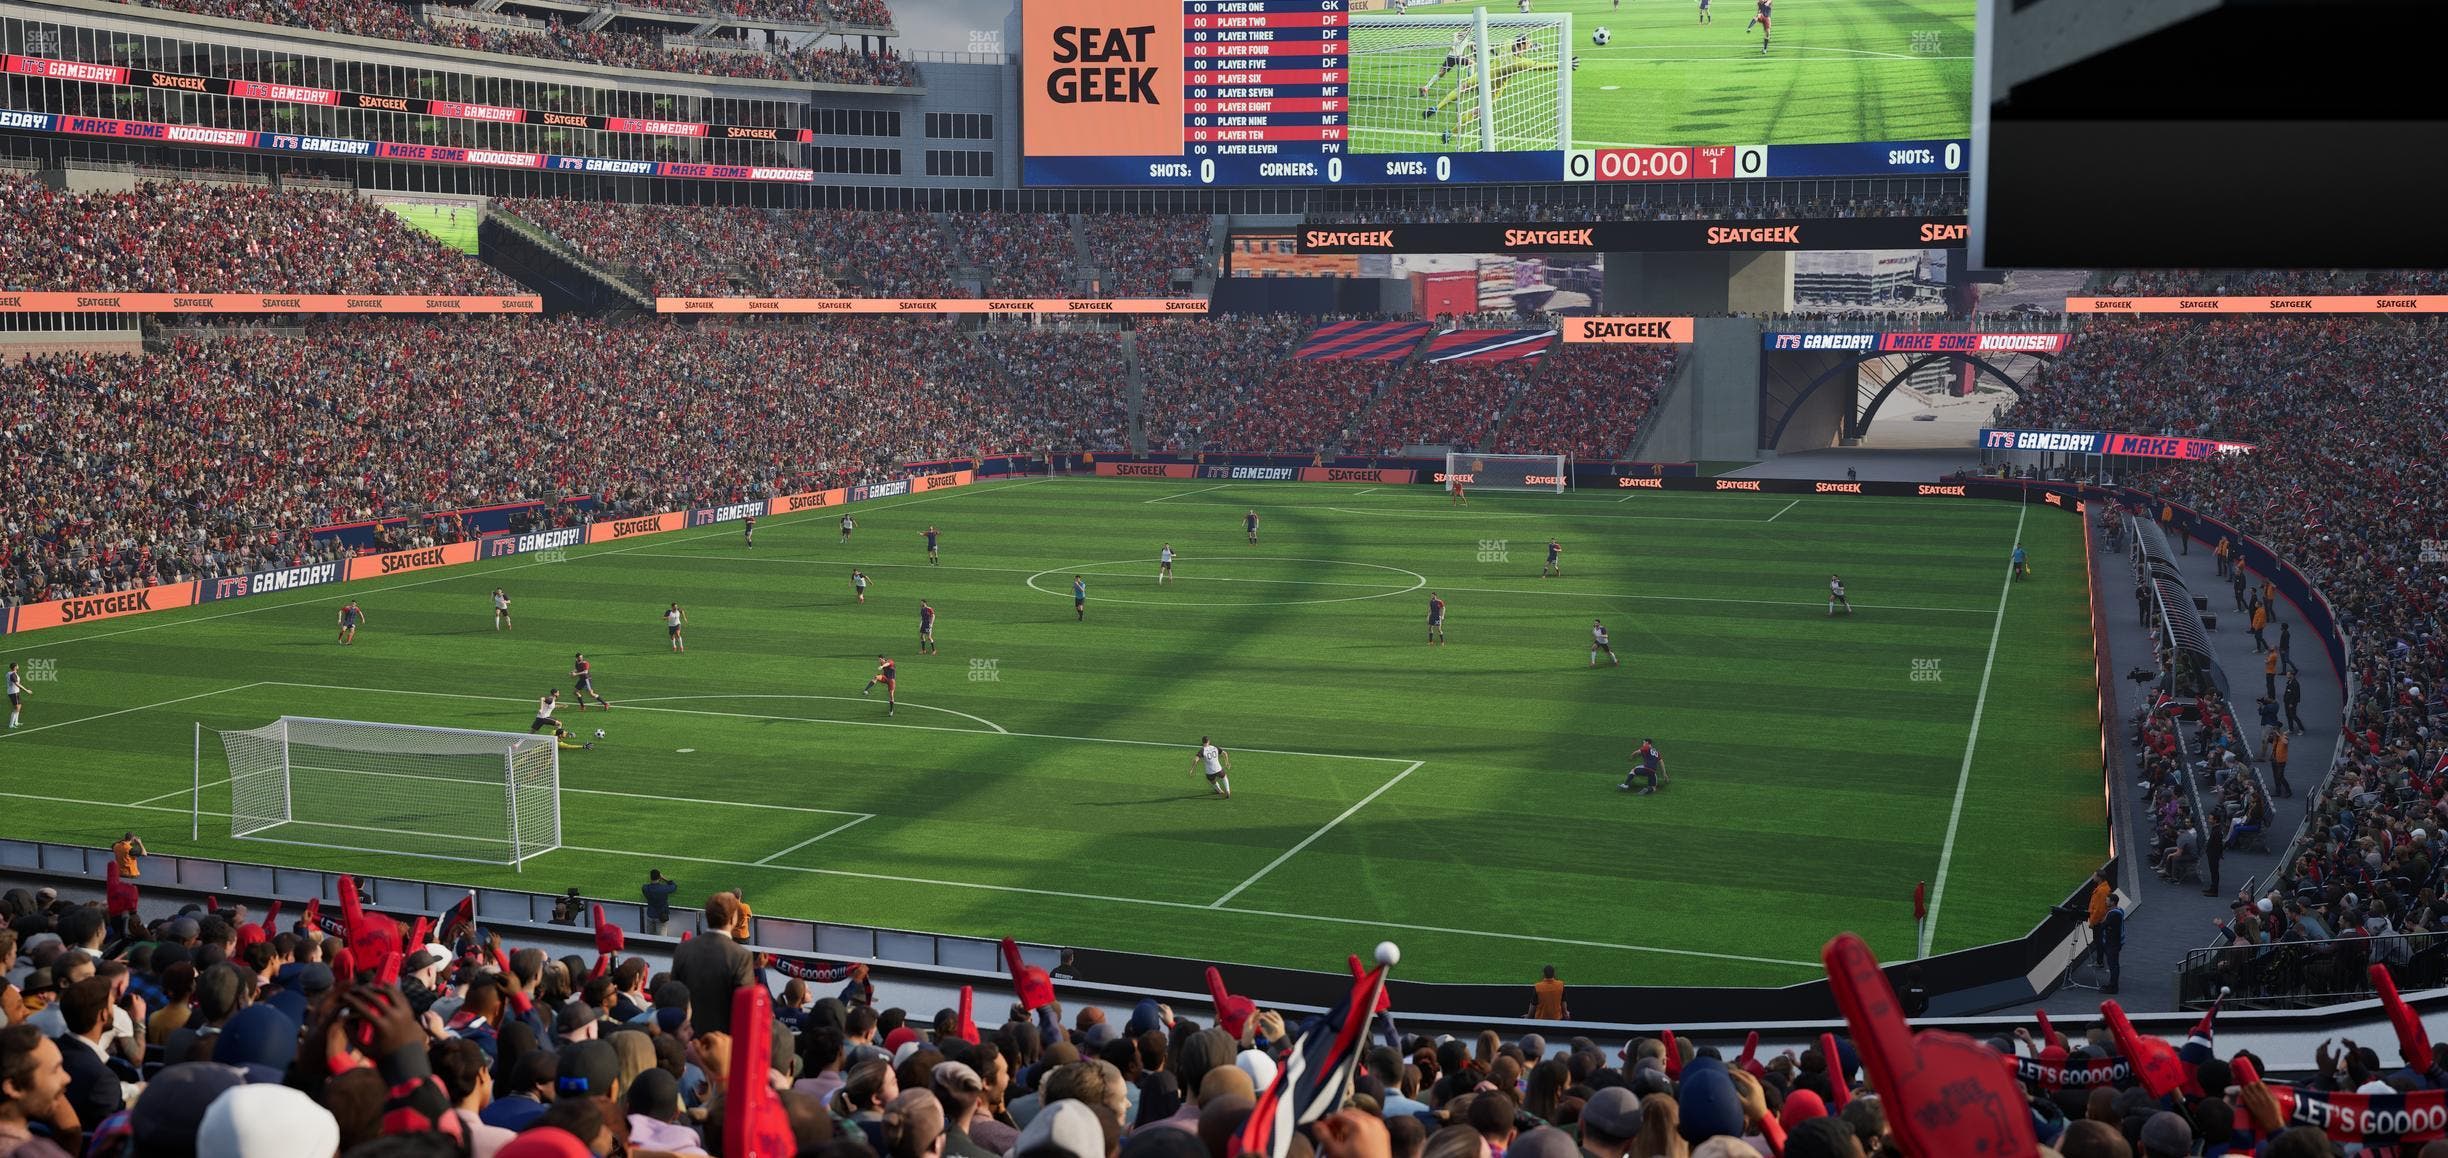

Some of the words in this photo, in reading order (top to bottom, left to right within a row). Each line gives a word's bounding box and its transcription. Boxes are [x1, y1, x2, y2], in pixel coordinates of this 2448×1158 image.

[1194, 3, 1207, 13] 00
[1218, 2, 1246, 12] PLAYER
[1248, 2, 1264, 12] ONE
[1322, 1, 1339, 10] GK
[1194, 18, 1207, 27] 00
[1218, 17, 1246, 28] PLAYER
[1248, 17, 1266, 27] TWO
[1322, 16, 1338, 25] DF
[1194, 32, 1207, 41] 00
[1218, 32, 1246, 41] PLAYER
[1248, 31, 1274, 40] THREE
[1322, 30, 1338, 39] DF
[1053, 25, 1156, 63] SEAT
[1194, 46, 1207, 55] 00
[1218, 46, 1246, 56] PLAYER
[1248, 46, 1269, 55] FOUR
[1322, 44, 1338, 54] DF
[21, 59, 45, 73] IT'S
[49, 62, 117, 81] GAMEDAY!
[1194, 60, 1207, 70] 00
[1218, 60, 1246, 70] PLAYER
[1248, 60, 1266, 70] FIVE
[1322, 58, 1338, 68] DF
[152, 73, 207, 92] SEATGEEK
[1194, 74, 1207, 84] 00
[1218, 74, 1246, 84] PLAYER
[1248, 74, 1262, 84] SIX
[1322, 72, 1339, 82] MF
[246, 84, 268, 97] IT'S
[272, 86, 328, 103] GAMEDAY!
[1046, 67, 1160, 105] GEEK
[1194, 89, 1207, 98] 00
[1218, 88, 1246, 98] PLAYER
[1248, 88, 1274, 98] SEVEN
[1322, 87, 1339, 96] MF
[359, 95, 408, 111] SEATGEEK
[1194, 103, 1207, 112] 00
[1218, 102, 1246, 112] PLAYER
[1248, 102, 1271, 112] EIGHT
[1322, 101, 1339, 110] MF
[0, 111, 48, 129] EDAY!
[443, 103, 462, 116] IT'S
[464, 106, 516, 122] GAMEDAY!
[544, 113, 588, 128] SEATGEEK
[624, 120, 642, 132] IT'S
[645, 122, 698, 136] GAMEDAY!
[1194, 117, 1207, 126] 00
[1218, 117, 1246, 126] PLAYER
[1248, 116, 1267, 126] NINE
[1322, 115, 1339, 125] MF
[72, 118, 117, 134] MAKE
[124, 123, 164, 138] SOME
[168, 126, 247, 145] NOOOOISE!!!
[728, 127, 776, 140] SEATGEEK
[1194, 131, 1207, 140] 00
[1218, 131, 1246, 140] PLAYER
[1248, 130, 1264, 140] TEN
[1322, 130, 1339, 138] FW
[272, 135, 298, 150] IT'S
[302, 138, 369, 154] GAMEDAY!
[1194, 145, 1207, 154] 00
[1218, 145, 1246, 155] PLAYER
[1248, 145, 1278, 154] ELEVEN
[1322, 144, 1339, 153] FW
[389, 145, 424, 158] MAKE
[431, 148, 464, 161] SOME
[467, 152, 536, 167] NOOOOISE!!!
[1702, 148, 1726, 157] HALF
[1888, 150, 1934, 165] SHOTS:
[1944, 142, 1960, 170] 0
[559, 158, 583, 170] IT'S
[586, 160, 651, 174] GAMEDAY!
[1386, 162, 1427, 176] SAVES:
[1436, 155, 1450, 182] 0
[1570, 154, 1590, 177] 0
[1601, 151, 1688, 177] 00:00
[1710, 158, 1718, 175] 1
[1742, 150, 1761, 174] 0
[670, 165, 708, 176] MAKE
[712, 166, 748, 178] SOME
[1150, 163, 1192, 178] SHOTS:
[1200, 158, 1216, 184] 0
[1260, 162, 1318, 178] CORNERS:
[1328, 157, 1343, 183] 0
[1306, 230, 1394, 248] SEATGEEK
[1504, 228, 1594, 247] SEATGEEK
[1708, 225, 1800, 245] SEATGEEK
[77, 297, 120, 308] SEATGEEK
[174, 298, 214, 308] SEATGEEK
[262, 298, 300, 308] SEATGEEK
[347, 299, 383, 308] SEATGEEK
[426, 299, 460, 309] SEATGEEK
[502, 300, 534, 309] SEATGEEK
[684, 301, 714, 309] SEATGEEK
[750, 301, 780, 310] SEATGEEK
[818, 301, 852, 310] SEATGEEK
[899, 302, 937, 310] SEATGEEK
[988, 302, 1034, 310] SEATGEEK
[1069, 302, 1113, 310] SEATGEEK
[1166, 302, 1207, 310] SEATGEEK
[2095, 300, 2132, 309] SEATGEEK
[2180, 300, 2219, 309] SEATGEEK
[2270, 300, 2312, 308] SEATGEEK
[2376, 300, 2417, 308] SEATGEEK
[1584, 320, 1672, 339] SEATGEEK
[1776, 334, 1800, 349] IT'S
[1804, 335, 1873, 350] GAMEDAY!
[1892, 336, 1932, 349] MAKE
[1938, 336, 1976, 349] SOME
[1980, 335, 2058, 350] NOOOOISE!!!
[1987, 431, 2015, 448] IT'S
[2018, 432, 2095, 452] GAMEDAY!
[2121, 438, 2180, 456] MAKE
[1116, 464, 1167, 478] SEATGEEK
[1232, 468, 1292, 480] GAMEDAY!
[1328, 468, 1382, 482] SEATGEEK
[927, 473, 957, 489] SEATGEEK
[1619, 477, 1662, 489] SEATGEEK
[1716, 480, 1760, 492] SEATGEEK
[1816, 482, 1862, 494] SEATGEEK
[869, 481, 908, 499] GAMEDAY!
[1918, 484, 1966, 496] SEATGEEK
[789, 493, 827, 512] SEATGEEK
[716, 501, 764, 522] GAMEDAY!
[613, 516, 662, 538] SEATGEEK
[492, 537, 516, 557] IT'S
[518, 528, 580, 552] GAMEDAY!
[381, 548, 446, 574] SEATGEEK
[216, 576, 248, 600] IT'S
[252, 563, 335, 594] GAMEDAY!
[61, 589, 152, 623] SEATGEEK
[2018, 1059, 2057, 1084] LET'S
[2293, 1093, 2355, 1132] LET'S
